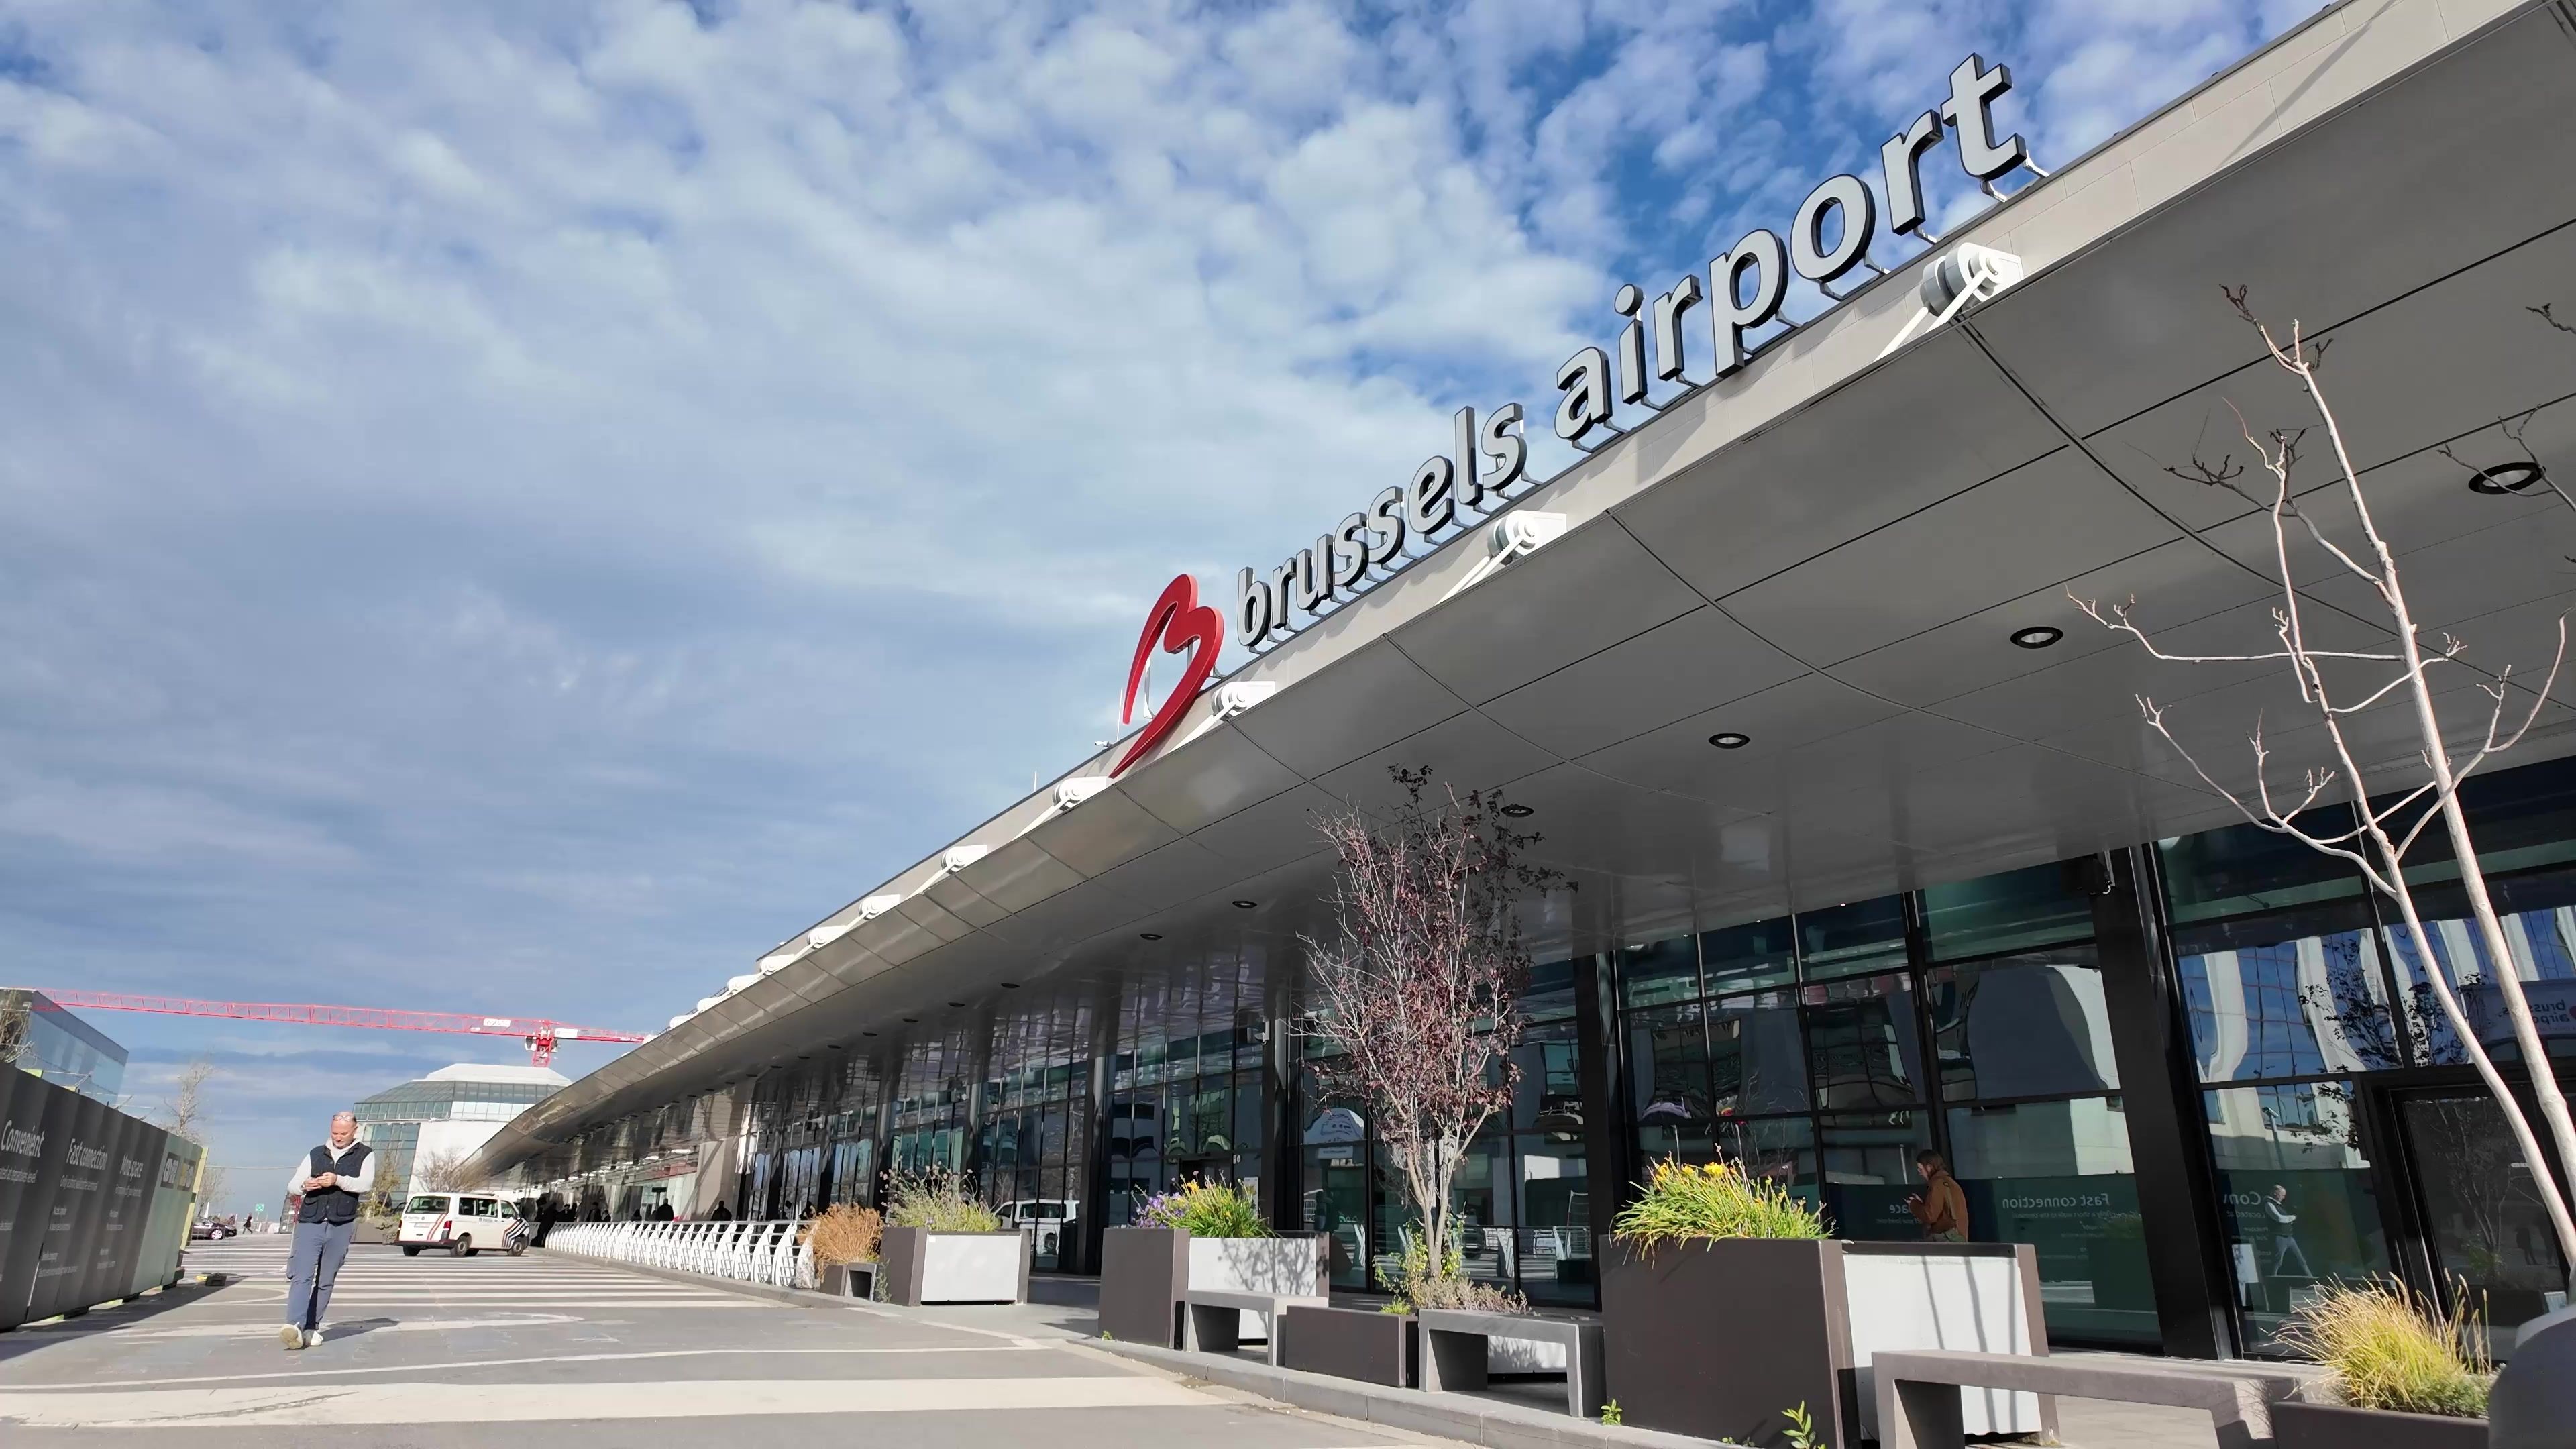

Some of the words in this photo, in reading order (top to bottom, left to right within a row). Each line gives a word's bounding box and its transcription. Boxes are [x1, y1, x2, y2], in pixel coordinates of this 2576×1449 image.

[1237, 402, 1527, 647] brussels
[1554, 52, 2027, 441] airport
[1, 1120, 45, 1158] Convenient
[66, 1138, 83, 1165] Fast
[79, 1145, 107, 1171] connection
[120, 1153, 132, 1175] More
[130, 1160, 144, 1181] space
